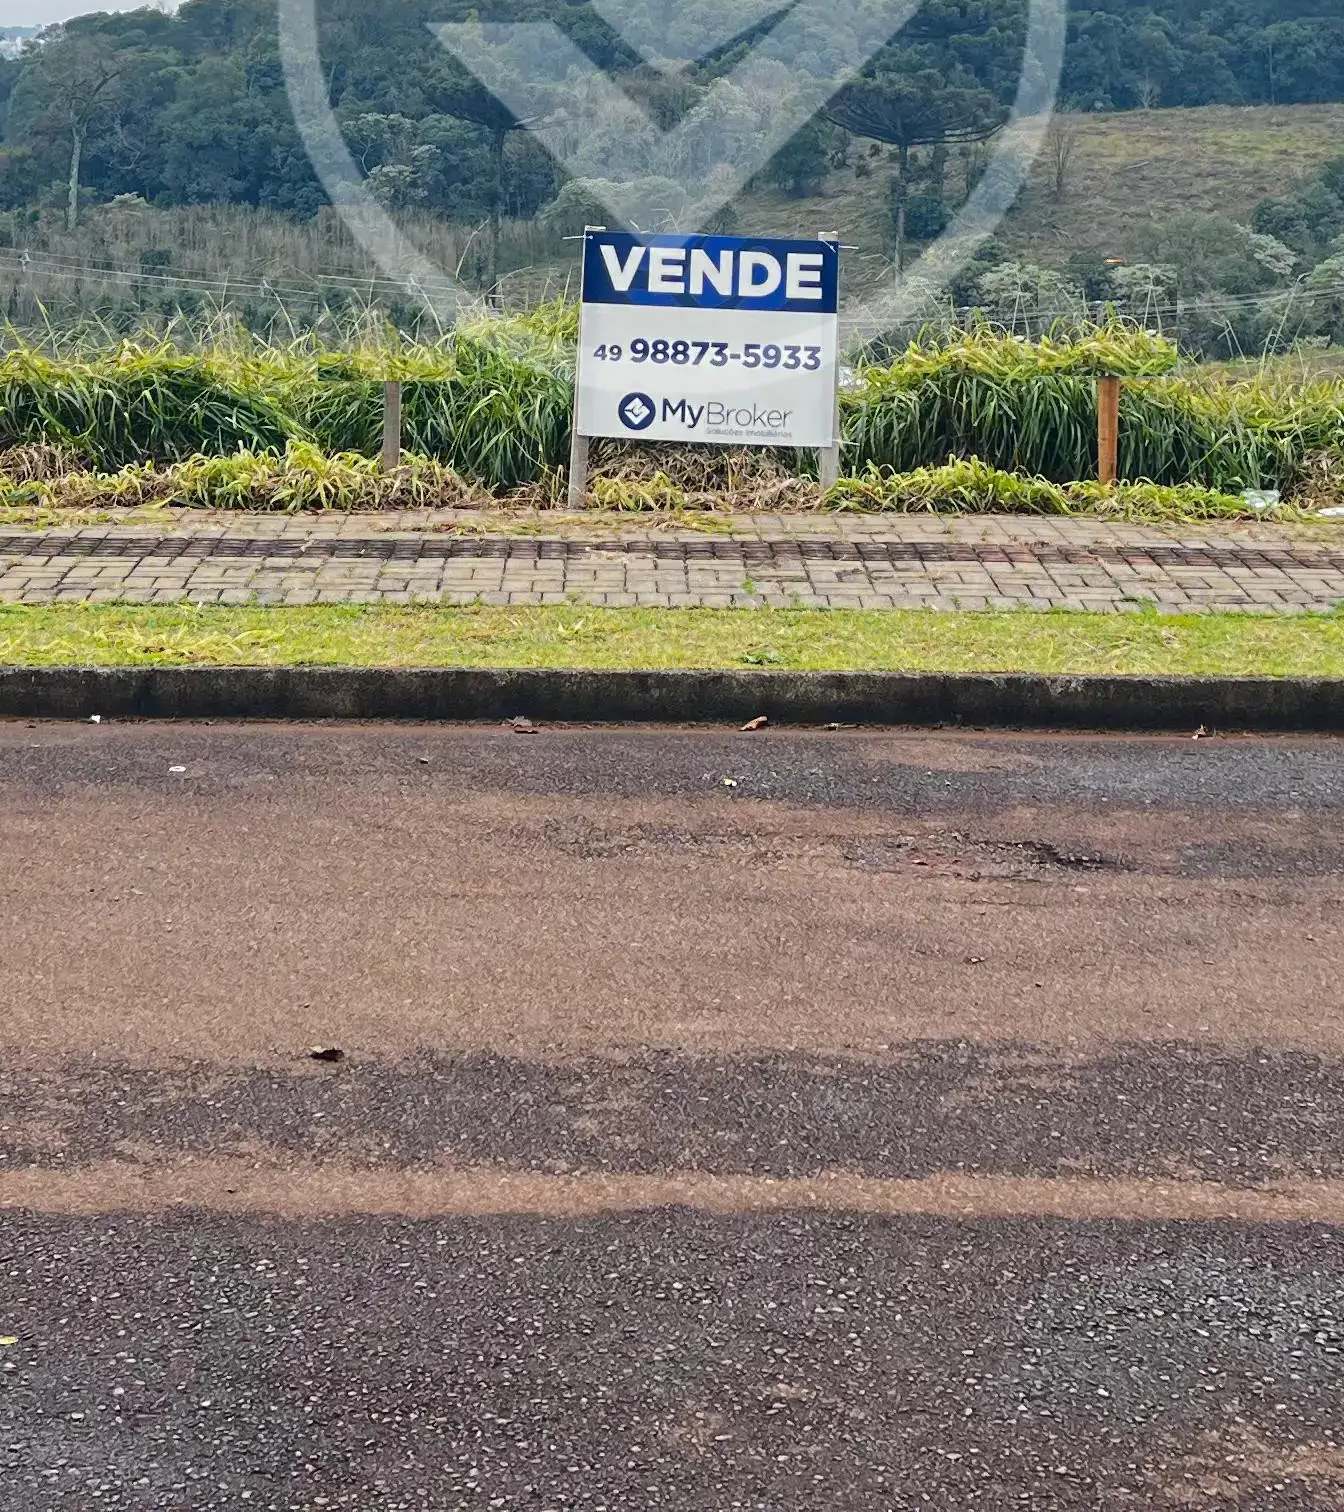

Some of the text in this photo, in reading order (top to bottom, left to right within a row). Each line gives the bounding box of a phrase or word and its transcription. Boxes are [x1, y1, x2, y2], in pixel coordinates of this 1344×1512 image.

[599, 244, 824, 299] VENDE
[593, 338, 821, 370] 49 98873-5933
